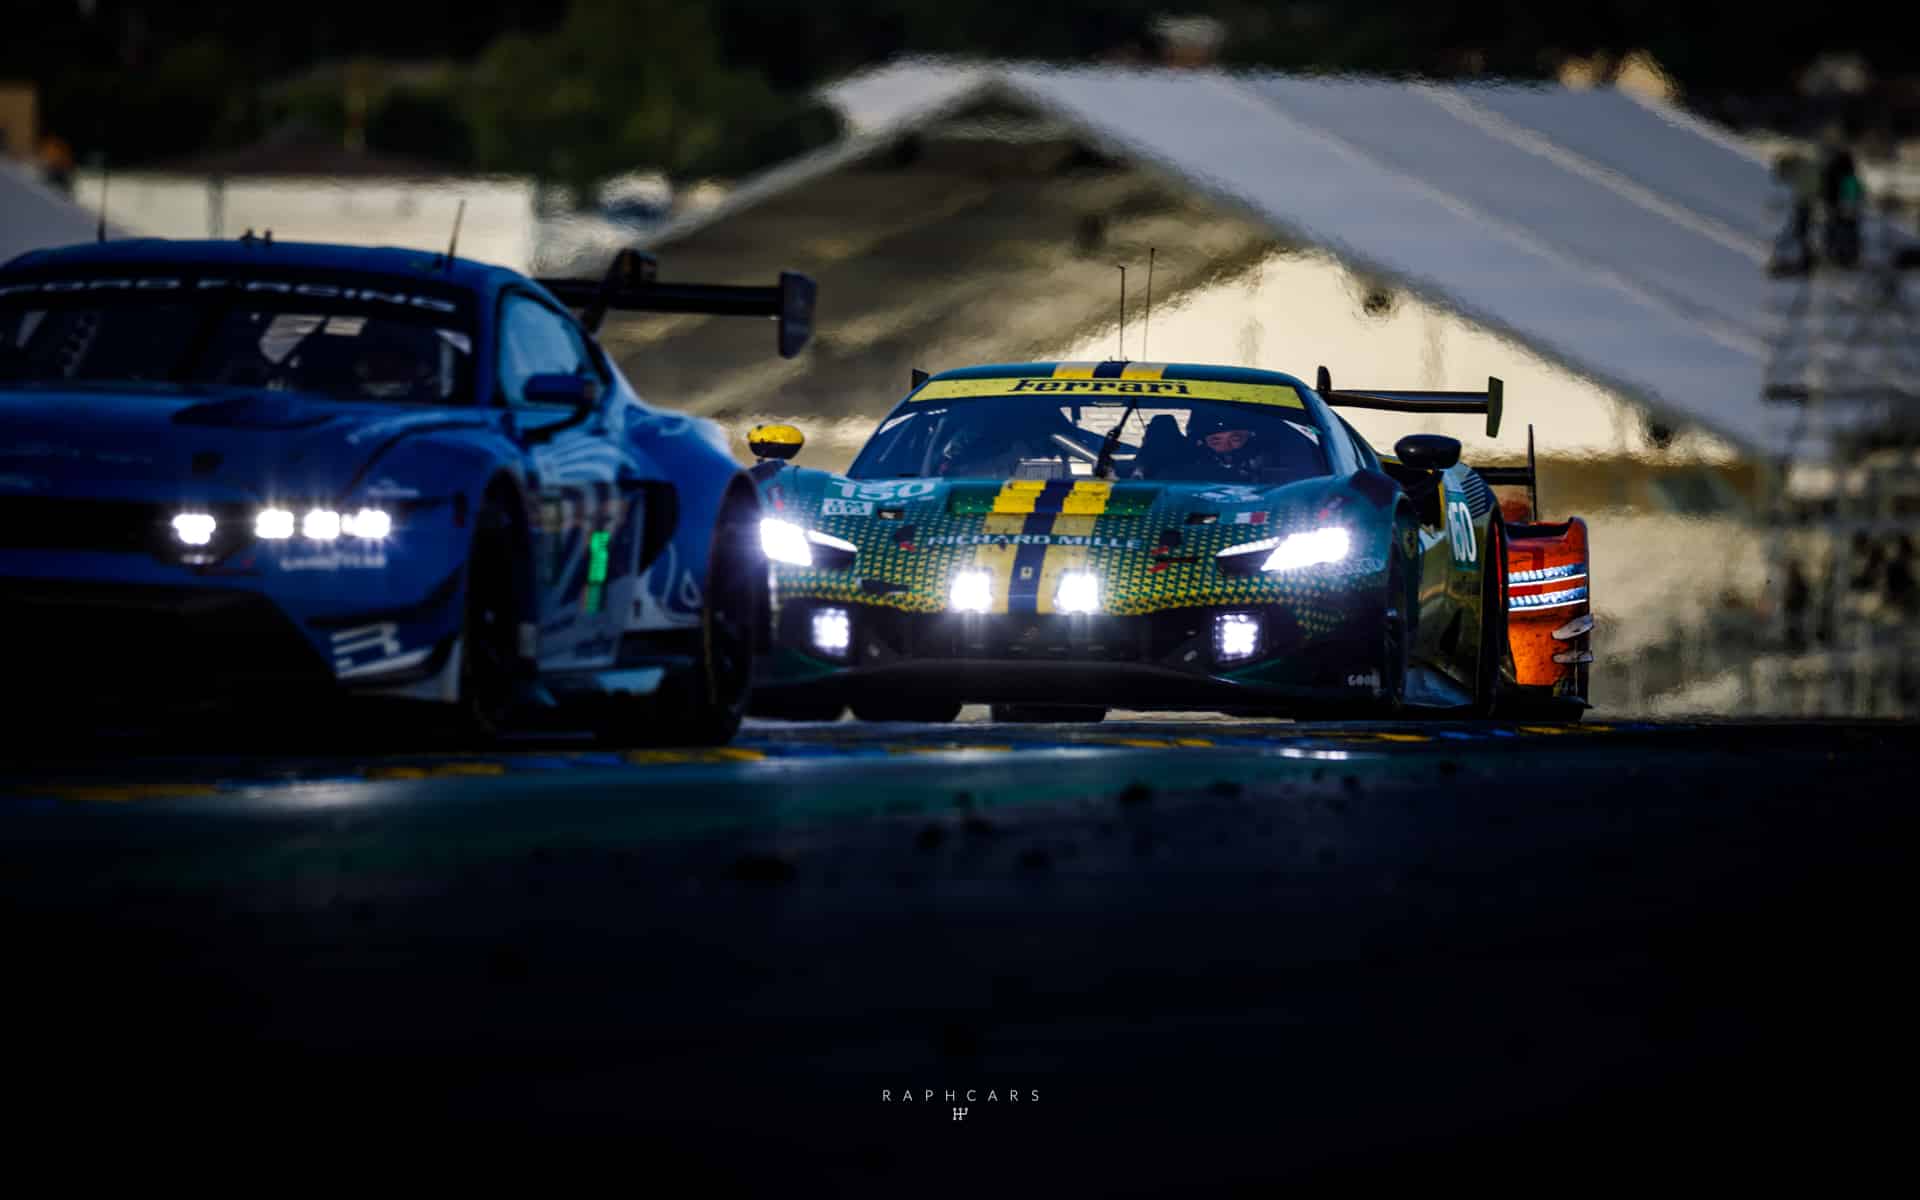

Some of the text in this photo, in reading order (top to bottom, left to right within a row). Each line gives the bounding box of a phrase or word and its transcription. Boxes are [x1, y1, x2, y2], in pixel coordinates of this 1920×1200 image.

[1007, 378, 1192, 395] Ferrari
[831, 478, 938, 500] 150
[927, 534, 1144, 550] RICHARD MILLE
